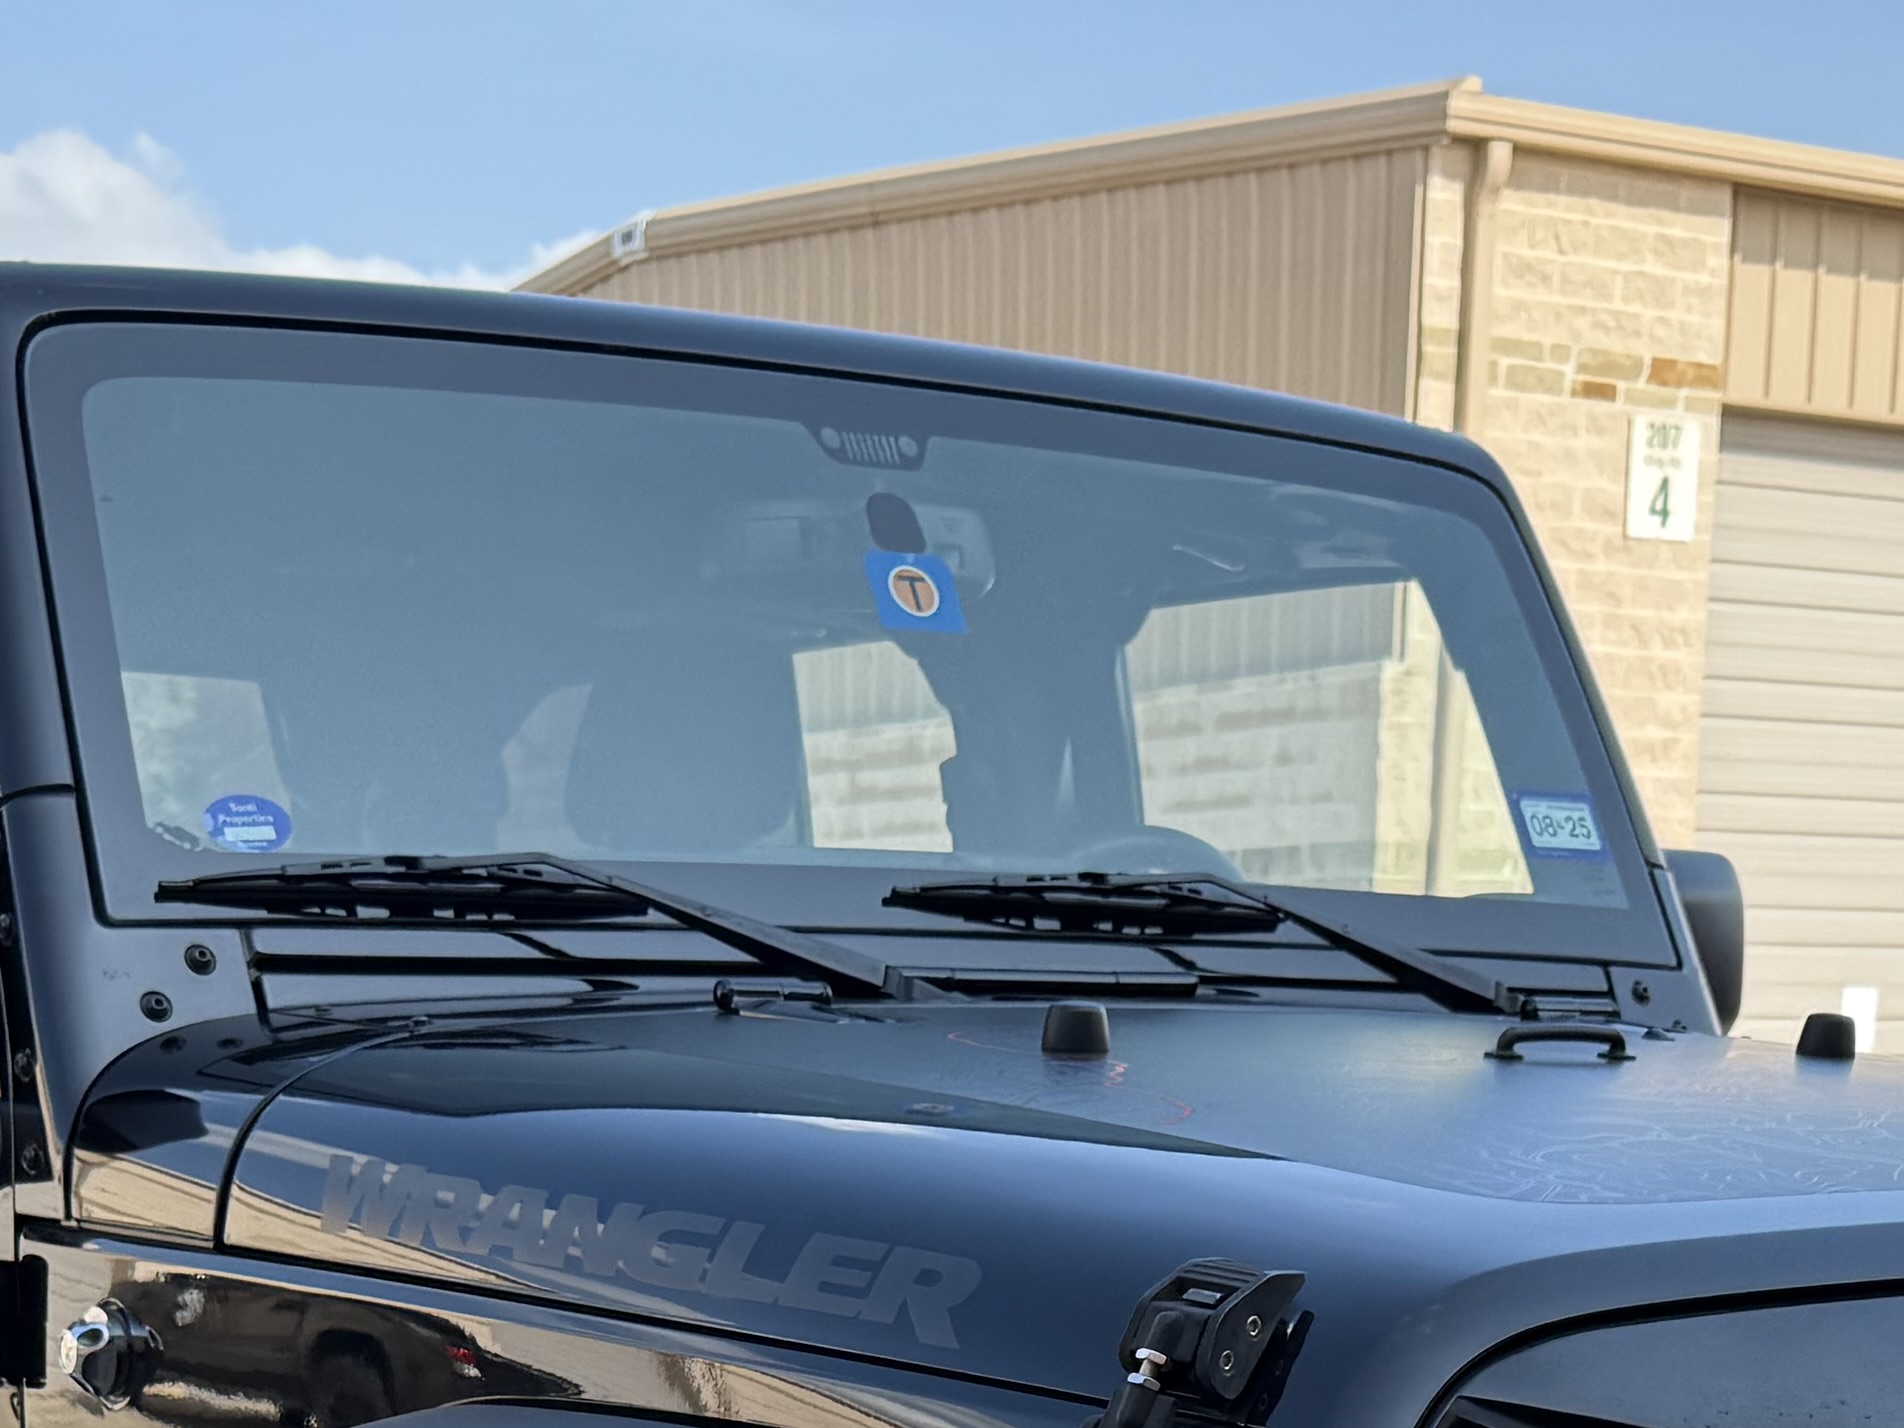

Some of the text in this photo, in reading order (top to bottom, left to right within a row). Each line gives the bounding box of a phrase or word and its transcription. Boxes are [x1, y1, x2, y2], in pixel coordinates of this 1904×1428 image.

[1648, 476, 1670, 529] 4
[897, 575, 927, 612] T
[319, 1154, 982, 1350] WRANGLER
